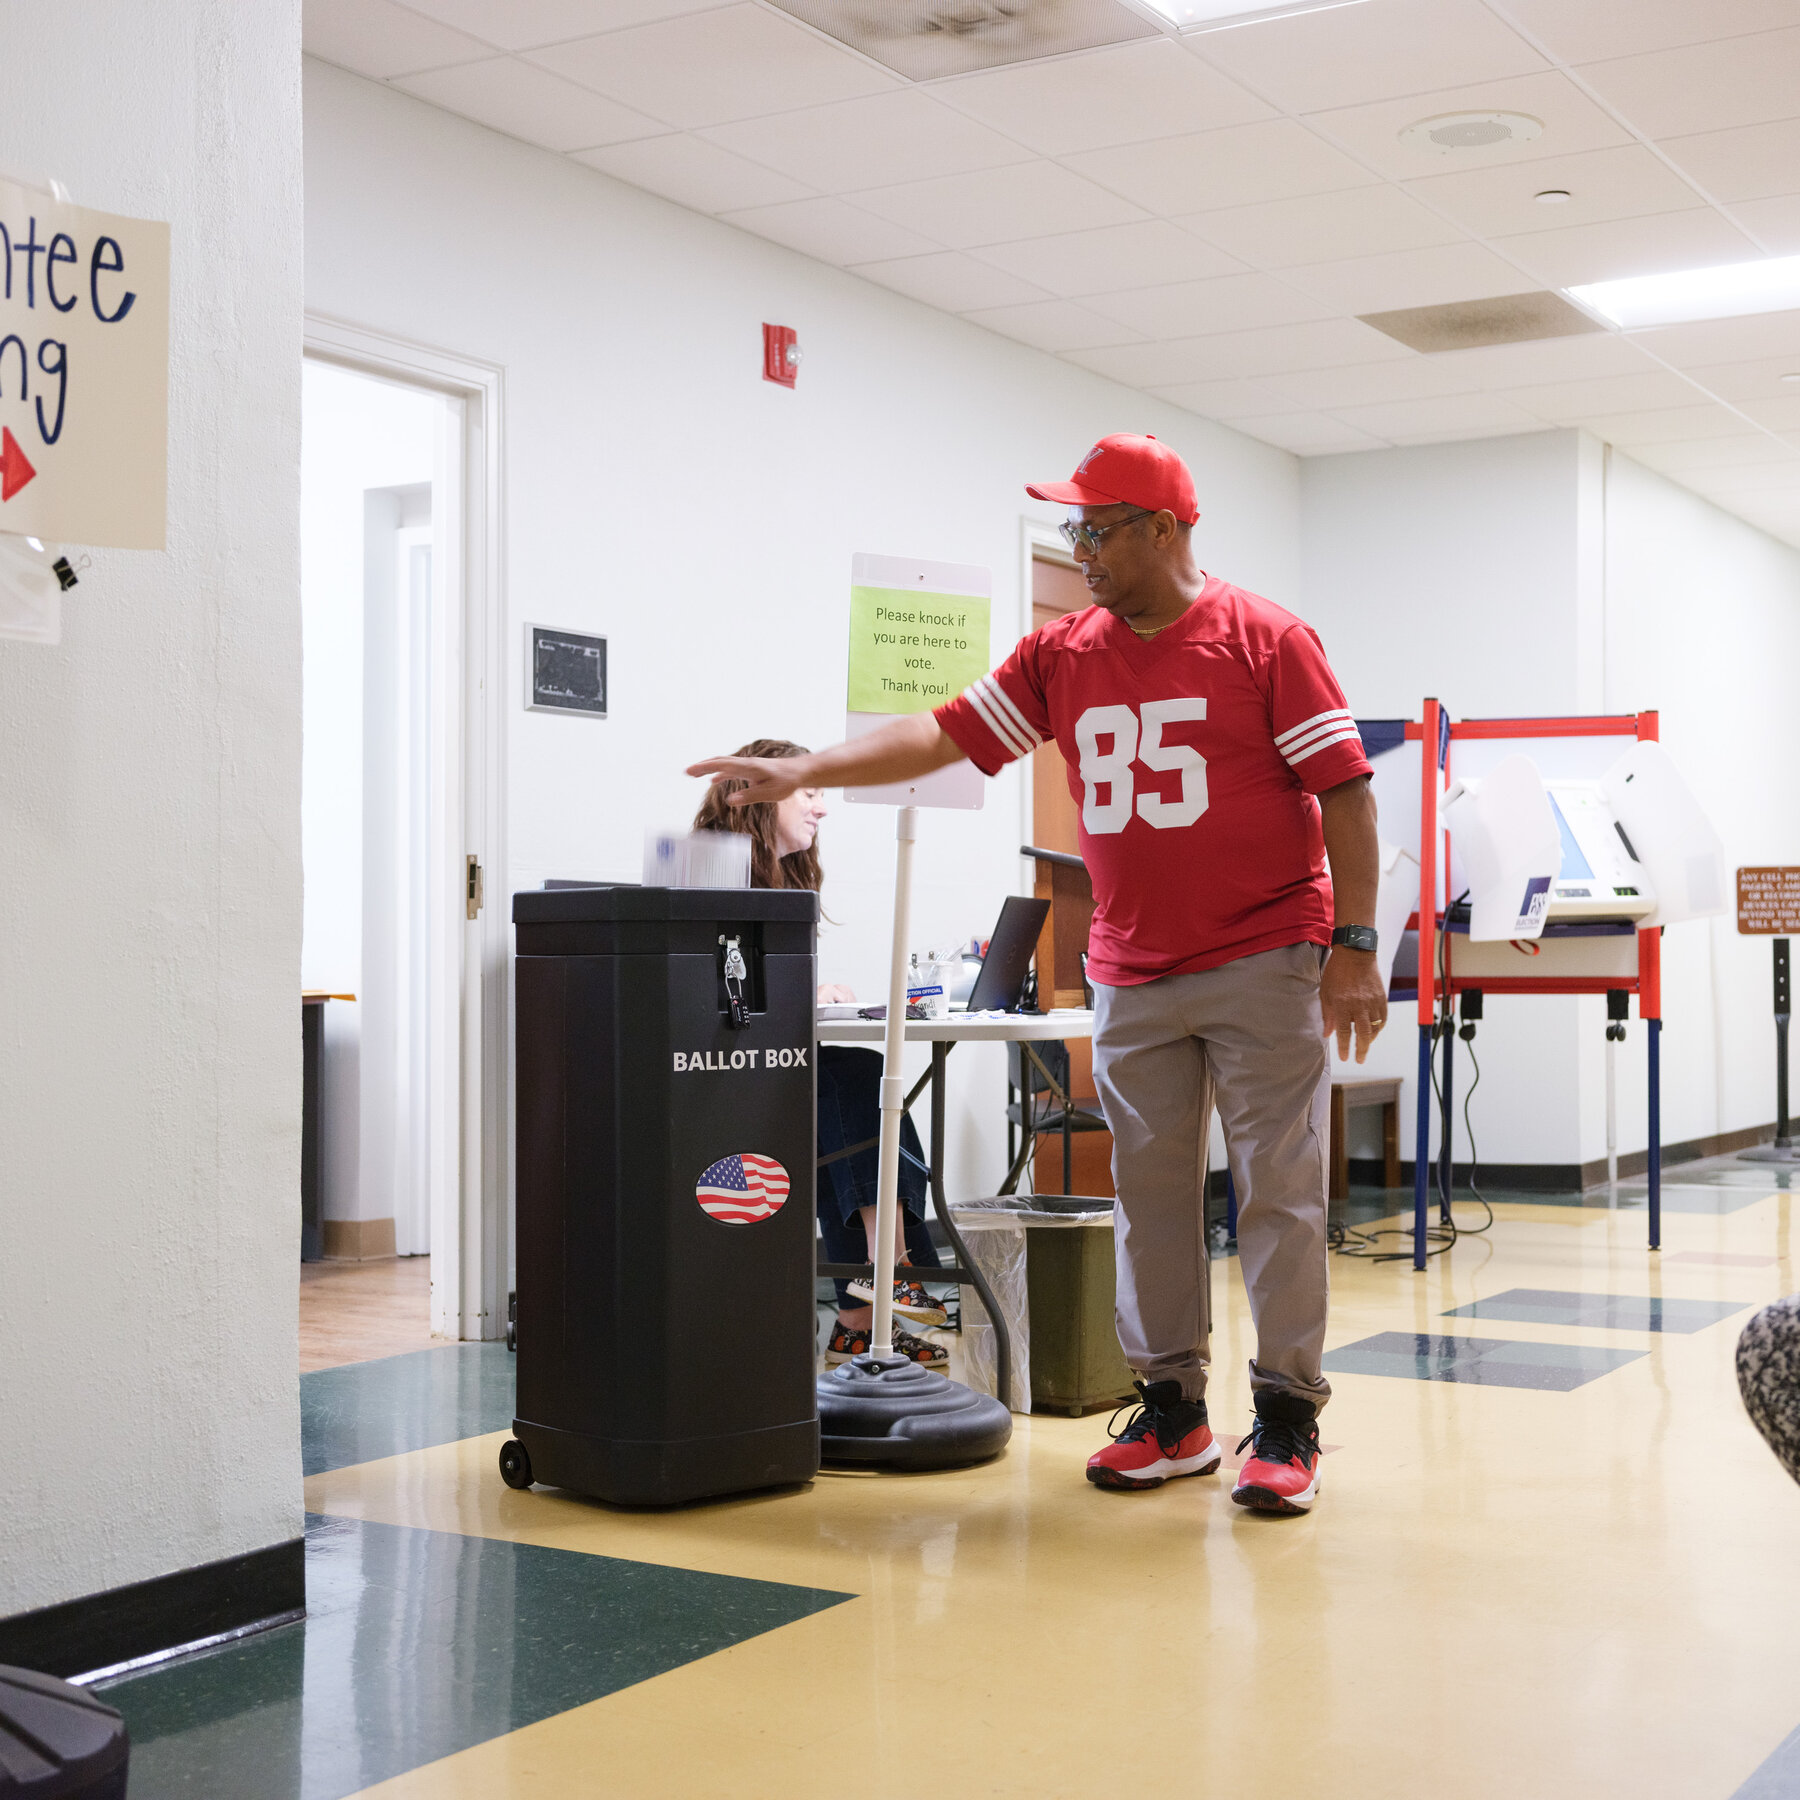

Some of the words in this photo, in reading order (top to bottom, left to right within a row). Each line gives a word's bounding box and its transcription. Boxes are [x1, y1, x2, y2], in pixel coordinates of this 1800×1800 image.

[876, 607, 915, 623] Please
[919, 610, 954, 626] knock
[958, 614, 966, 627] if
[873, 632, 896, 645] you
[899, 635, 920, 646] are
[923, 633, 951, 649] here
[954, 638, 967, 650] to
[904, 657, 935, 670] vote.
[881, 678, 918, 693] Thank
[921, 682, 949, 696] you!
[1075, 697, 1209, 835] 85
[673, 1050, 759, 1072] BALLOT
[765, 1047, 808, 1069] BOX
